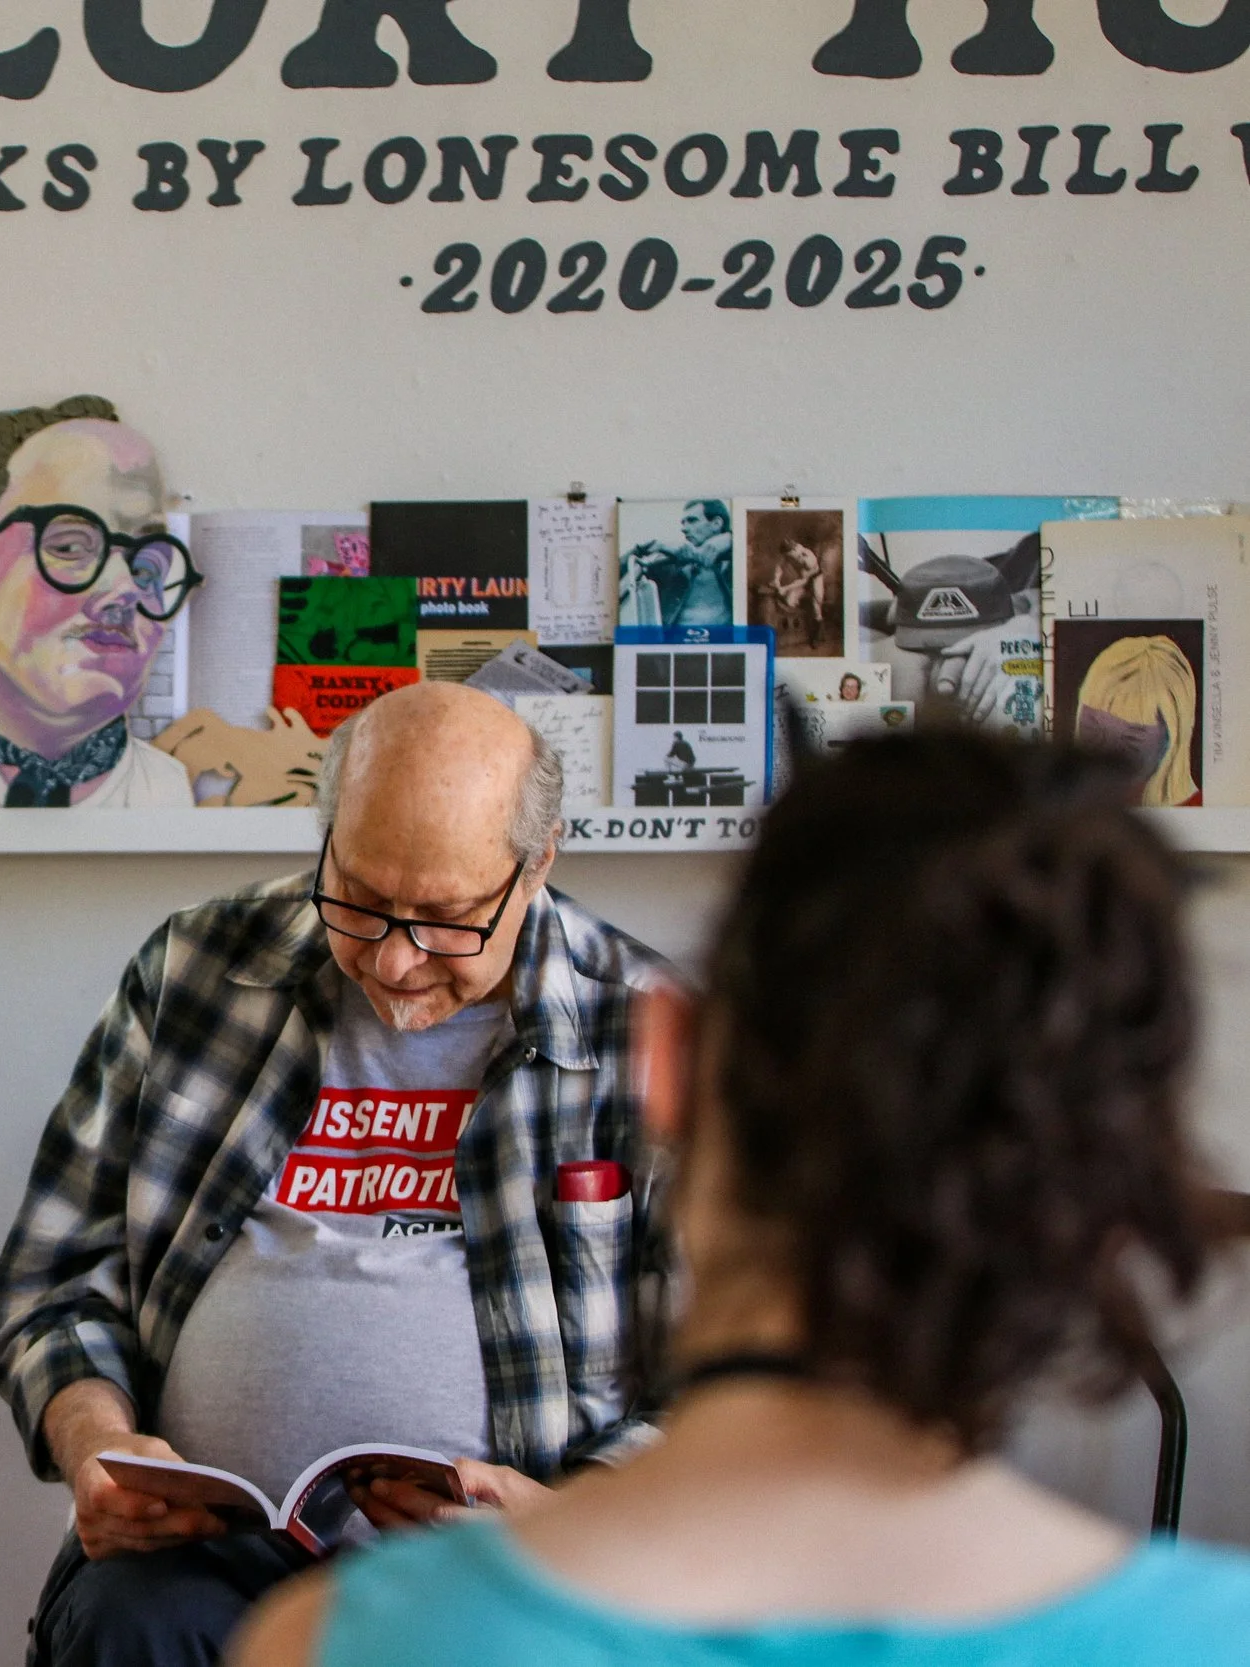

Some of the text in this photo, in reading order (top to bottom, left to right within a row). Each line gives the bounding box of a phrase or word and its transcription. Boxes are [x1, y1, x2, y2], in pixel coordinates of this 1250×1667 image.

[133, 139, 265, 212] BY
[292, 129, 900, 206] LONESOME
[943, 123, 1199, 196] BILL
[420, 601, 489, 616] photo book
[303, 1098, 448, 1142] ISSENT
